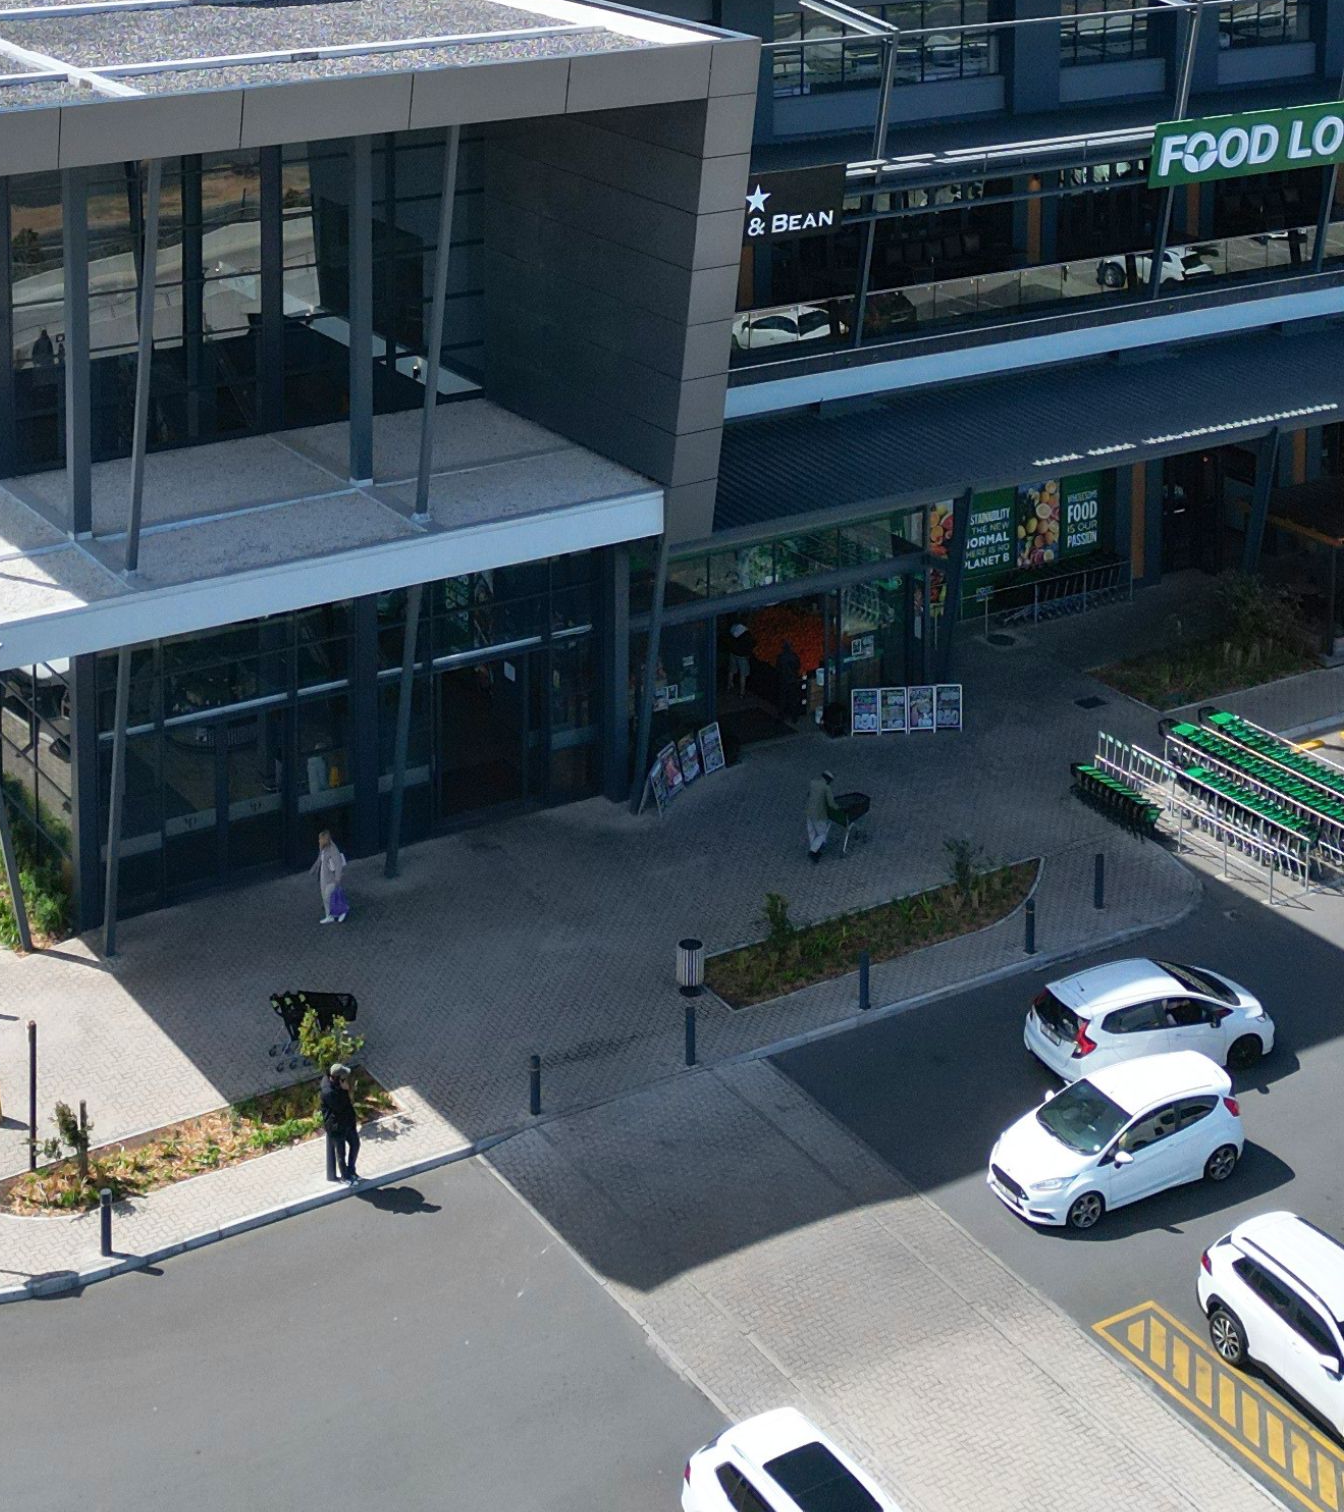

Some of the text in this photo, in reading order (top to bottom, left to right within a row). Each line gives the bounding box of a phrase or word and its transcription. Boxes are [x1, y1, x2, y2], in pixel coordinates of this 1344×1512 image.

[1158, 124, 1279, 176] FOOD
[748, 210, 834, 236] & BEAN
[1067, 500, 1097, 524] FOOD
[1077, 519, 1097, 531] OUR
[965, 548, 986, 559] HERE
[1003, 552, 1010, 562] B
